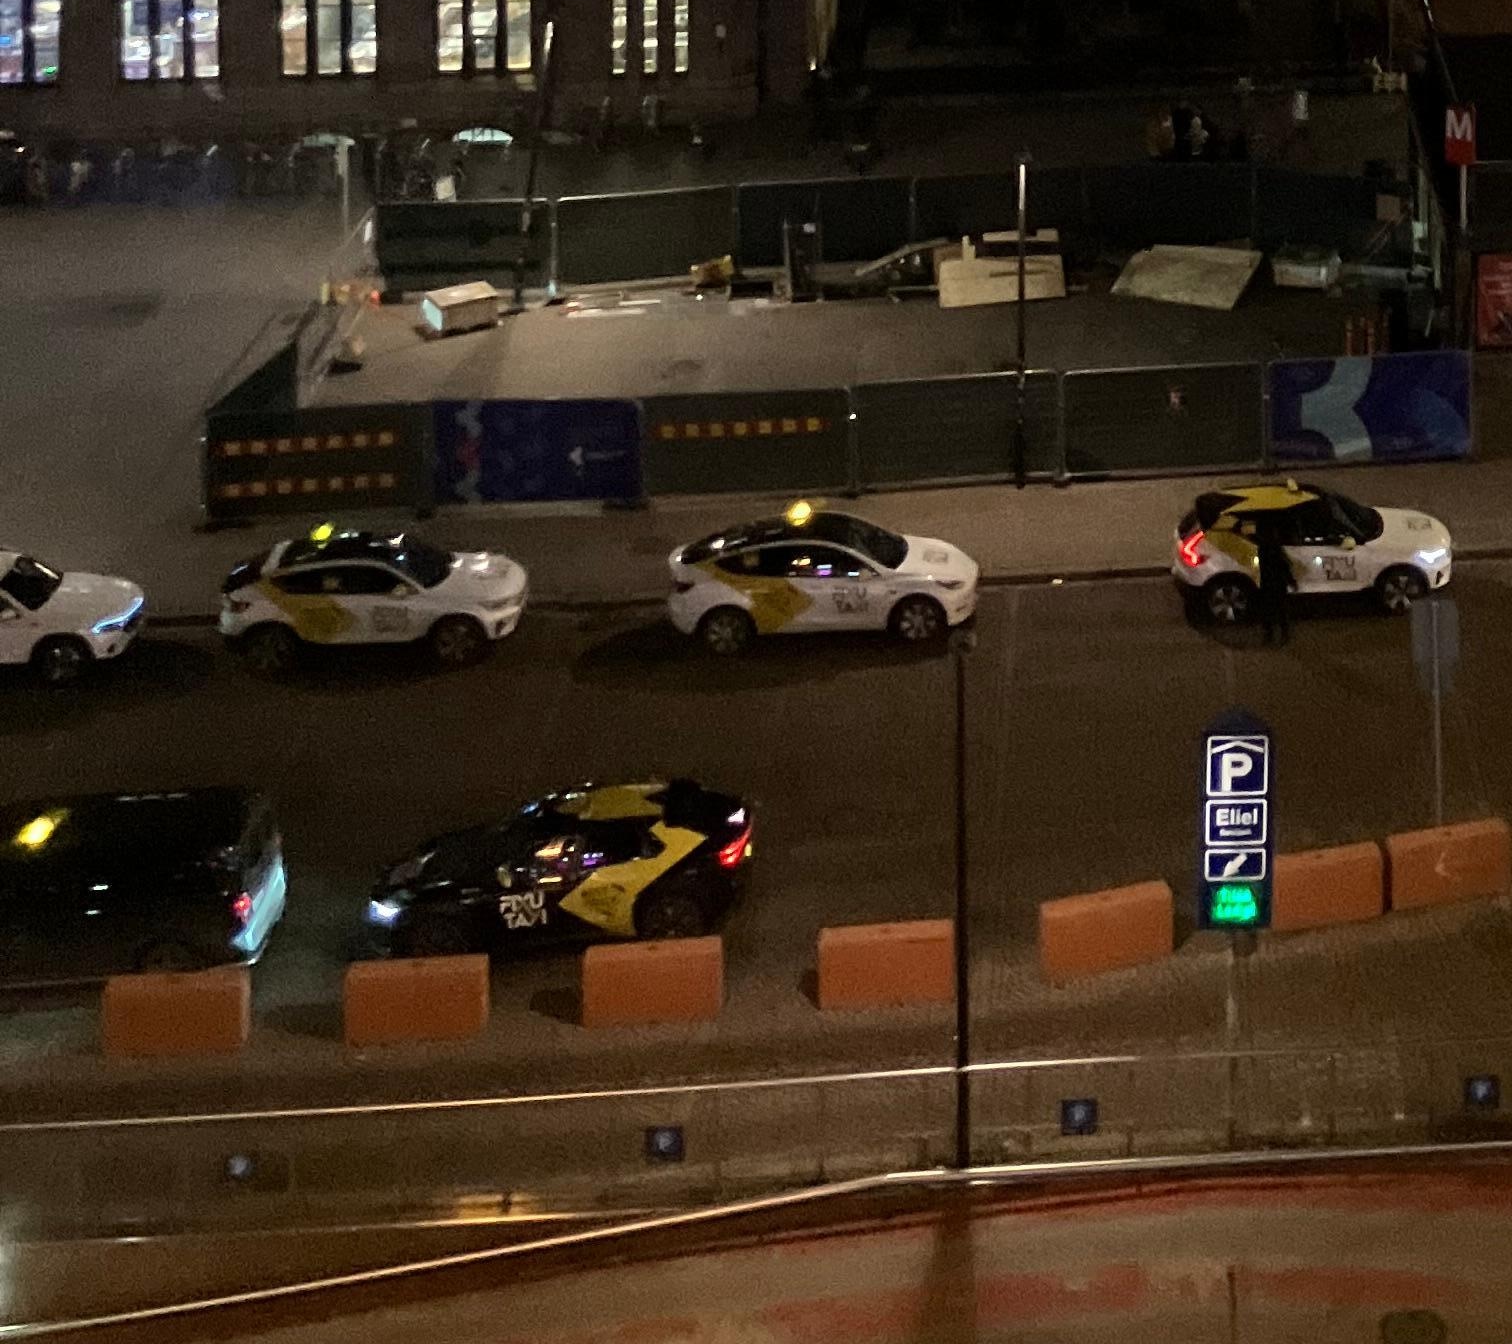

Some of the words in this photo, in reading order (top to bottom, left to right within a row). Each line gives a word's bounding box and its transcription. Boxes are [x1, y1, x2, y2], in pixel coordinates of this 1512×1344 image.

[1445, 109, 1473, 142] M
[1220, 752, 1253, 793] P
[1215, 808, 1258, 827] Eliel
[498, 889, 546, 914] FIXU
[503, 907, 547, 929] TAXI
